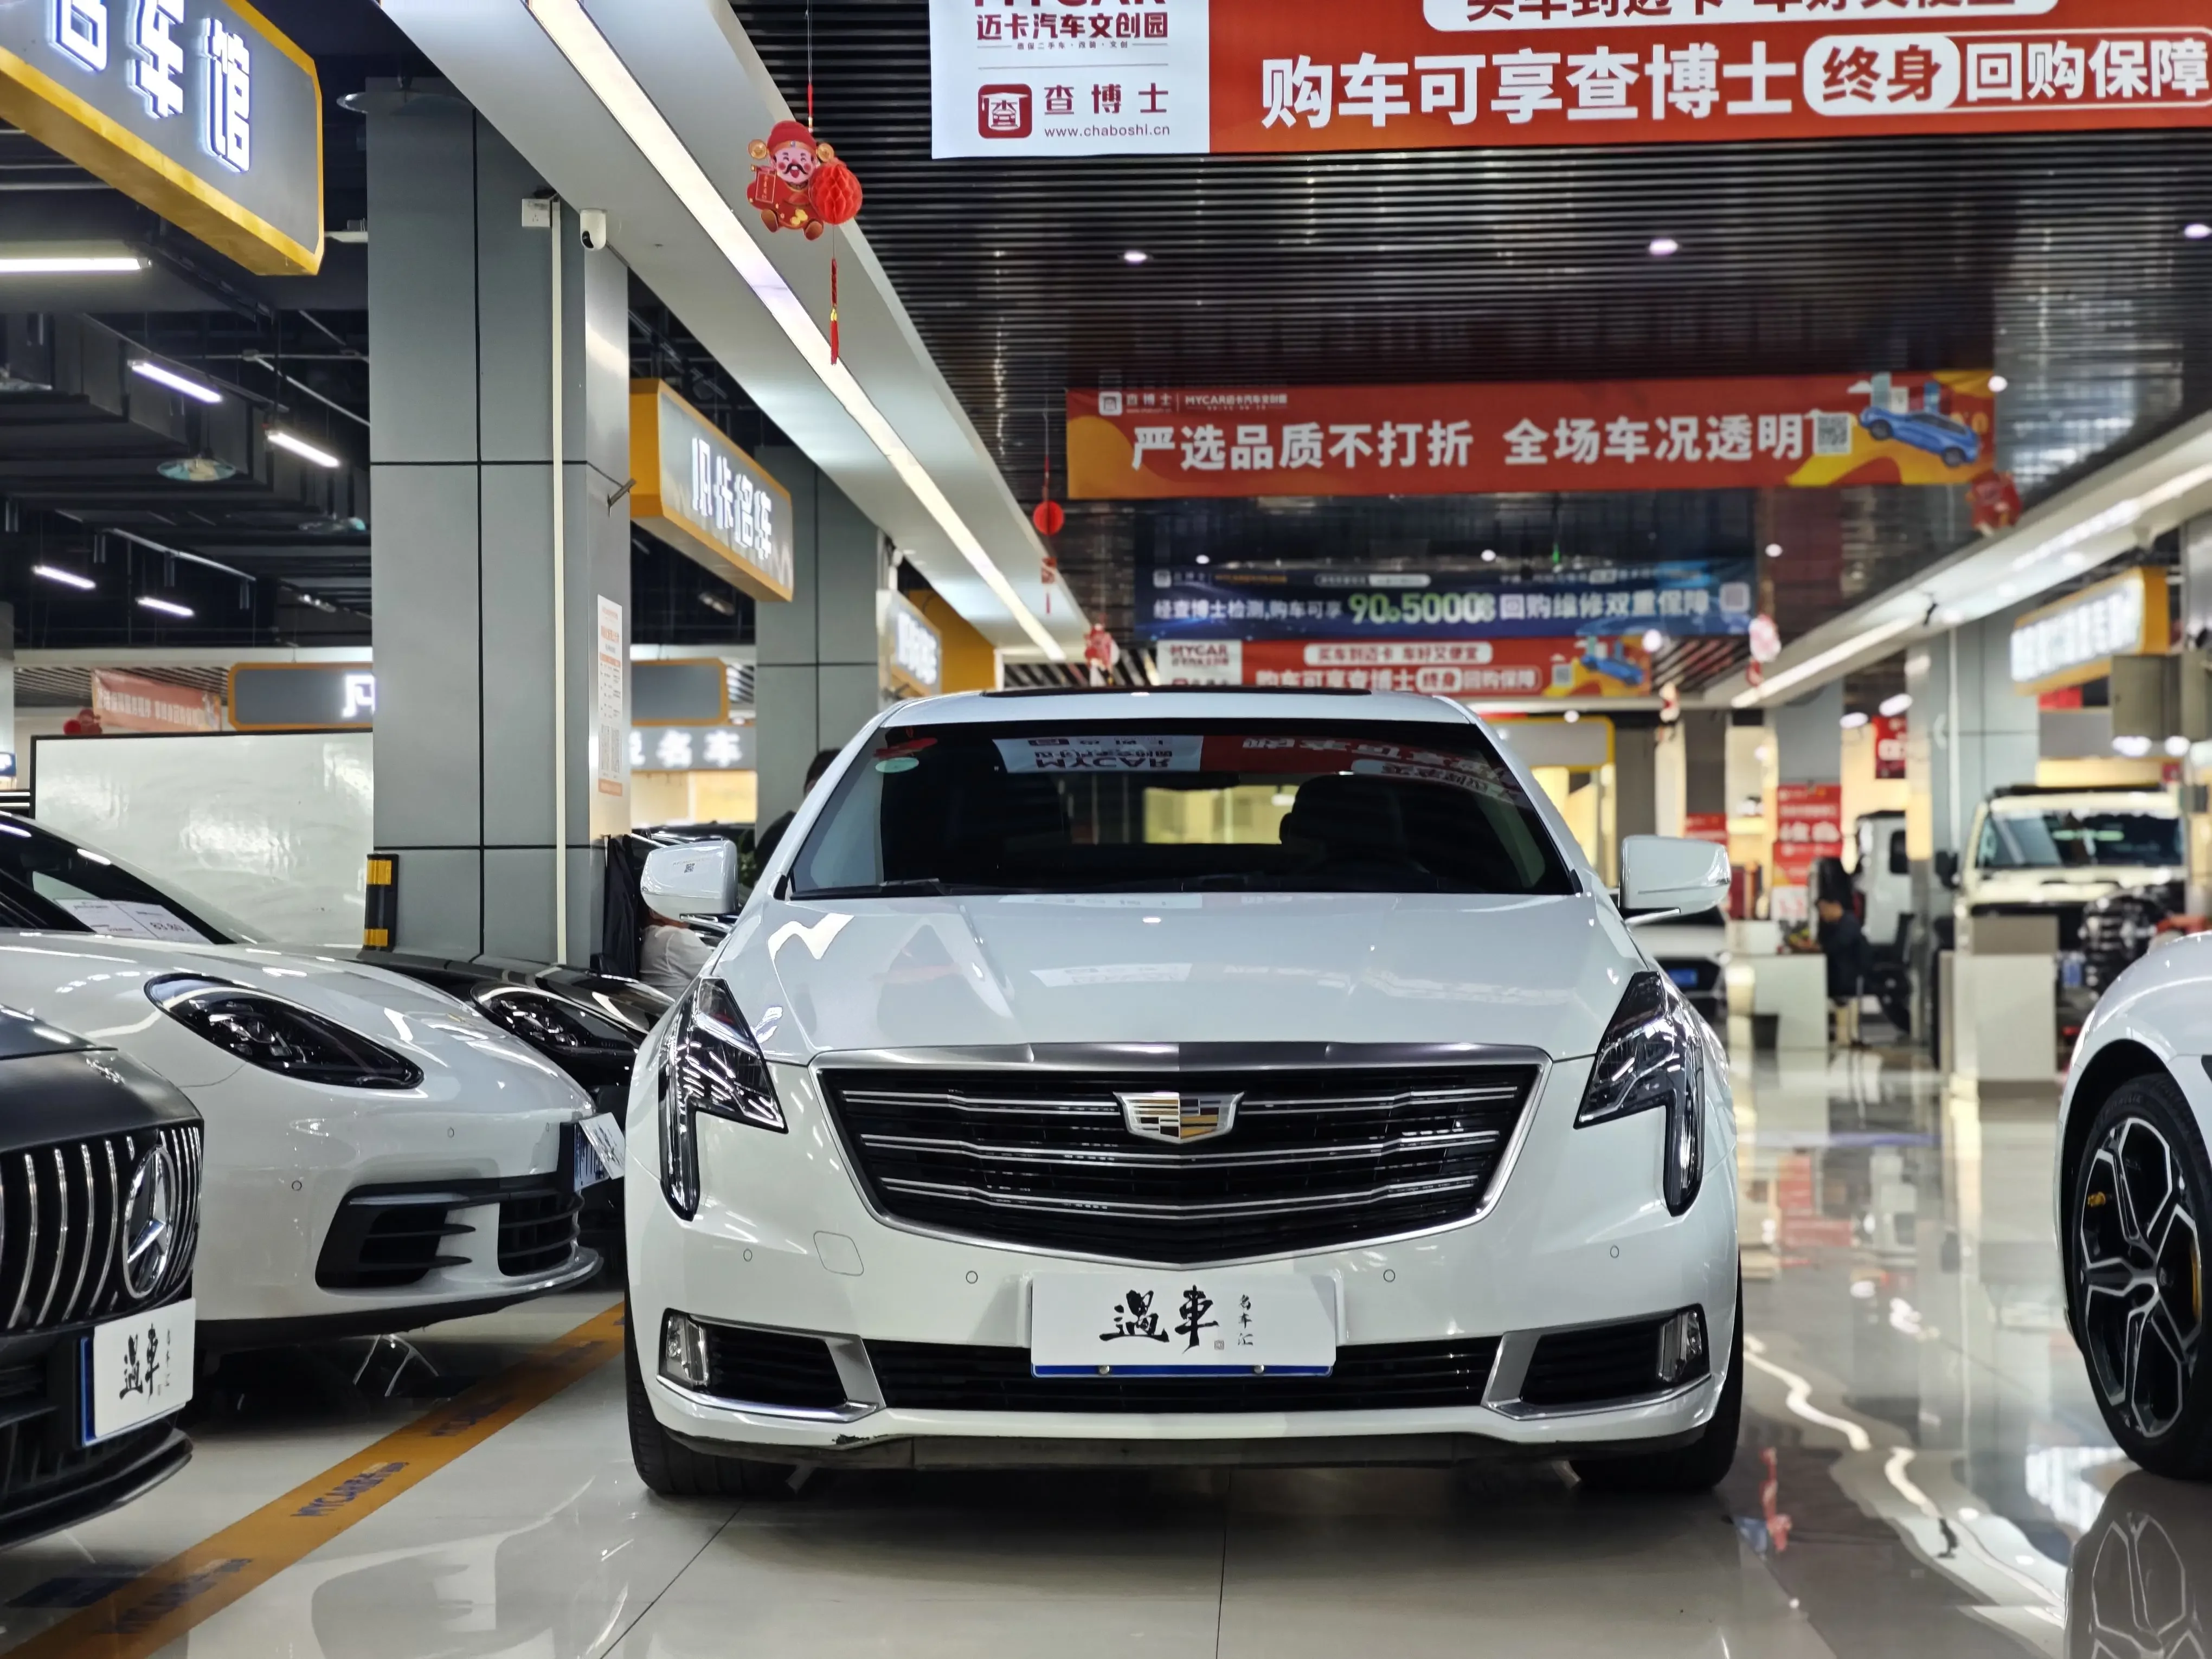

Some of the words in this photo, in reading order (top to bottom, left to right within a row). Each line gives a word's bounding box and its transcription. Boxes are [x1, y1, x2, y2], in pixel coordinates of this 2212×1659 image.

[976, 12, 1168, 40] 迈卡汽车文创园
[1044, 82, 1168, 115] 查博士
[1261, 41, 1797, 129] 购车可享查博士
[1822, 44, 1941, 104] 终身
[1966, 40, 2209, 101] 回购保障
[1044, 124, 1170, 137] www.chaboshi.cn
[1131, 419, 1474, 471] 严选品质不打折
[1502, 414, 1803, 465] 全场车况透明
